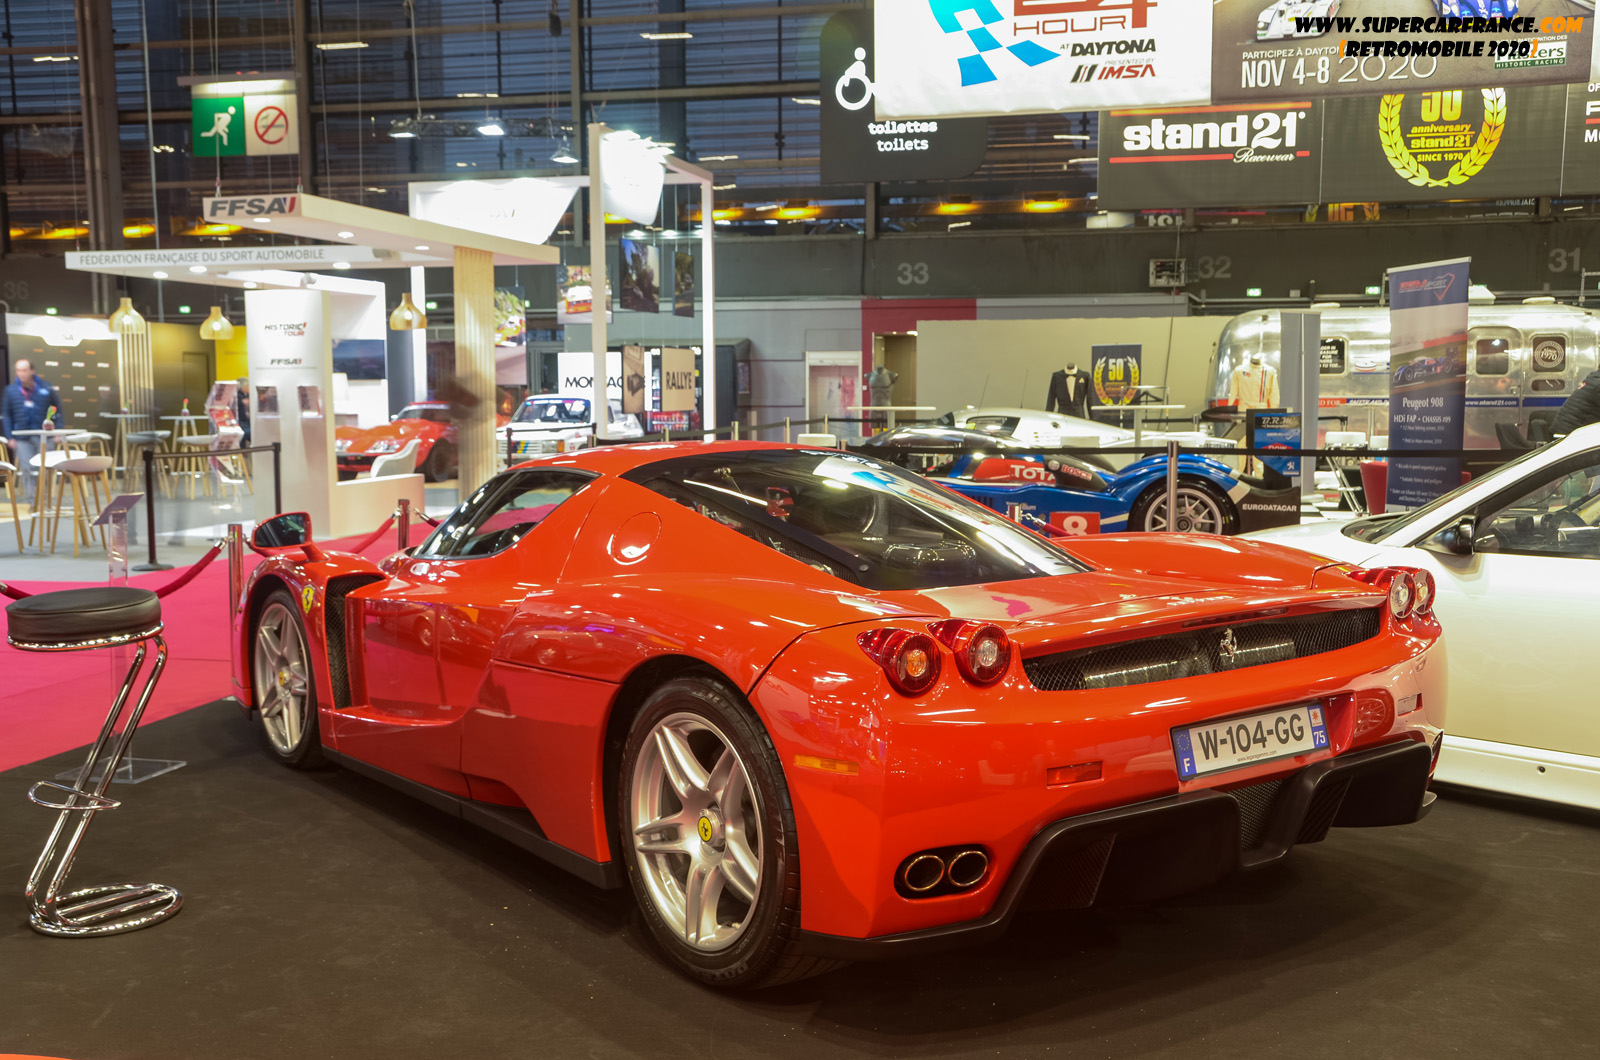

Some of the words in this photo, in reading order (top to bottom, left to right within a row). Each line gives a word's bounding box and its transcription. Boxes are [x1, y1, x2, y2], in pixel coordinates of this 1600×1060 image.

[1014, 15, 1126, 36] HOUR
[1071, 39, 1156, 57] DAYTONA
[1242, 49, 1294, 60] PARTICIPEZ
[1535, 58, 1564, 66] RACING
[1098, 64, 1156, 80] IMSA
[1241, 58, 1286, 88] NOV
[1292, 56, 1330, 85] 4-8
[868, 120, 938, 135] toilettes
[1123, 111, 1297, 151] stand21
[1411, 123, 1472, 134] anniversary
[877, 138, 929, 152] toilets
[1410, 134, 1471, 149] stand21
[1233, 147, 1295, 163] Racewear
[1417, 153, 1442, 162] SINCE
[1443, 152, 1464, 161] 1970
[209, 197, 288, 217] FFSA
[80, 253, 141, 265] FÉDÉRATION
[144, 251, 200, 265] FRANÇAISE
[202, 251, 218, 261] DU
[220, 251, 253, 261] SPORT
[256, 249, 325, 260] AUTOMOBILE
[1547, 247, 1581, 272] 31
[897, 262, 929, 285] 33
[1199, 256, 1231, 279] 32
[1540, 351, 1557, 361] 1970
[1108, 358, 1124, 381] 50
[666, 371, 692, 390] RALLYE
[1402, 396, 1429, 411] Peugeot
[1430, 396, 1444, 408] 908
[1394, 413, 1406, 423] HDi
[1407, 414, 1417, 423] FAP
[1422, 415, 1442, 423] CHASSIS
[1010, 464, 1056, 481] TOTA
[1061, 464, 1093, 481] BOSCH
[1242, 503, 1297, 511] EURODATACAR
[1062, 515, 1088, 536] 8
[1197, 713, 1305, 760] W-104-GG
[1313, 730, 1326, 745] 75
[1183, 758, 1191, 773] F
